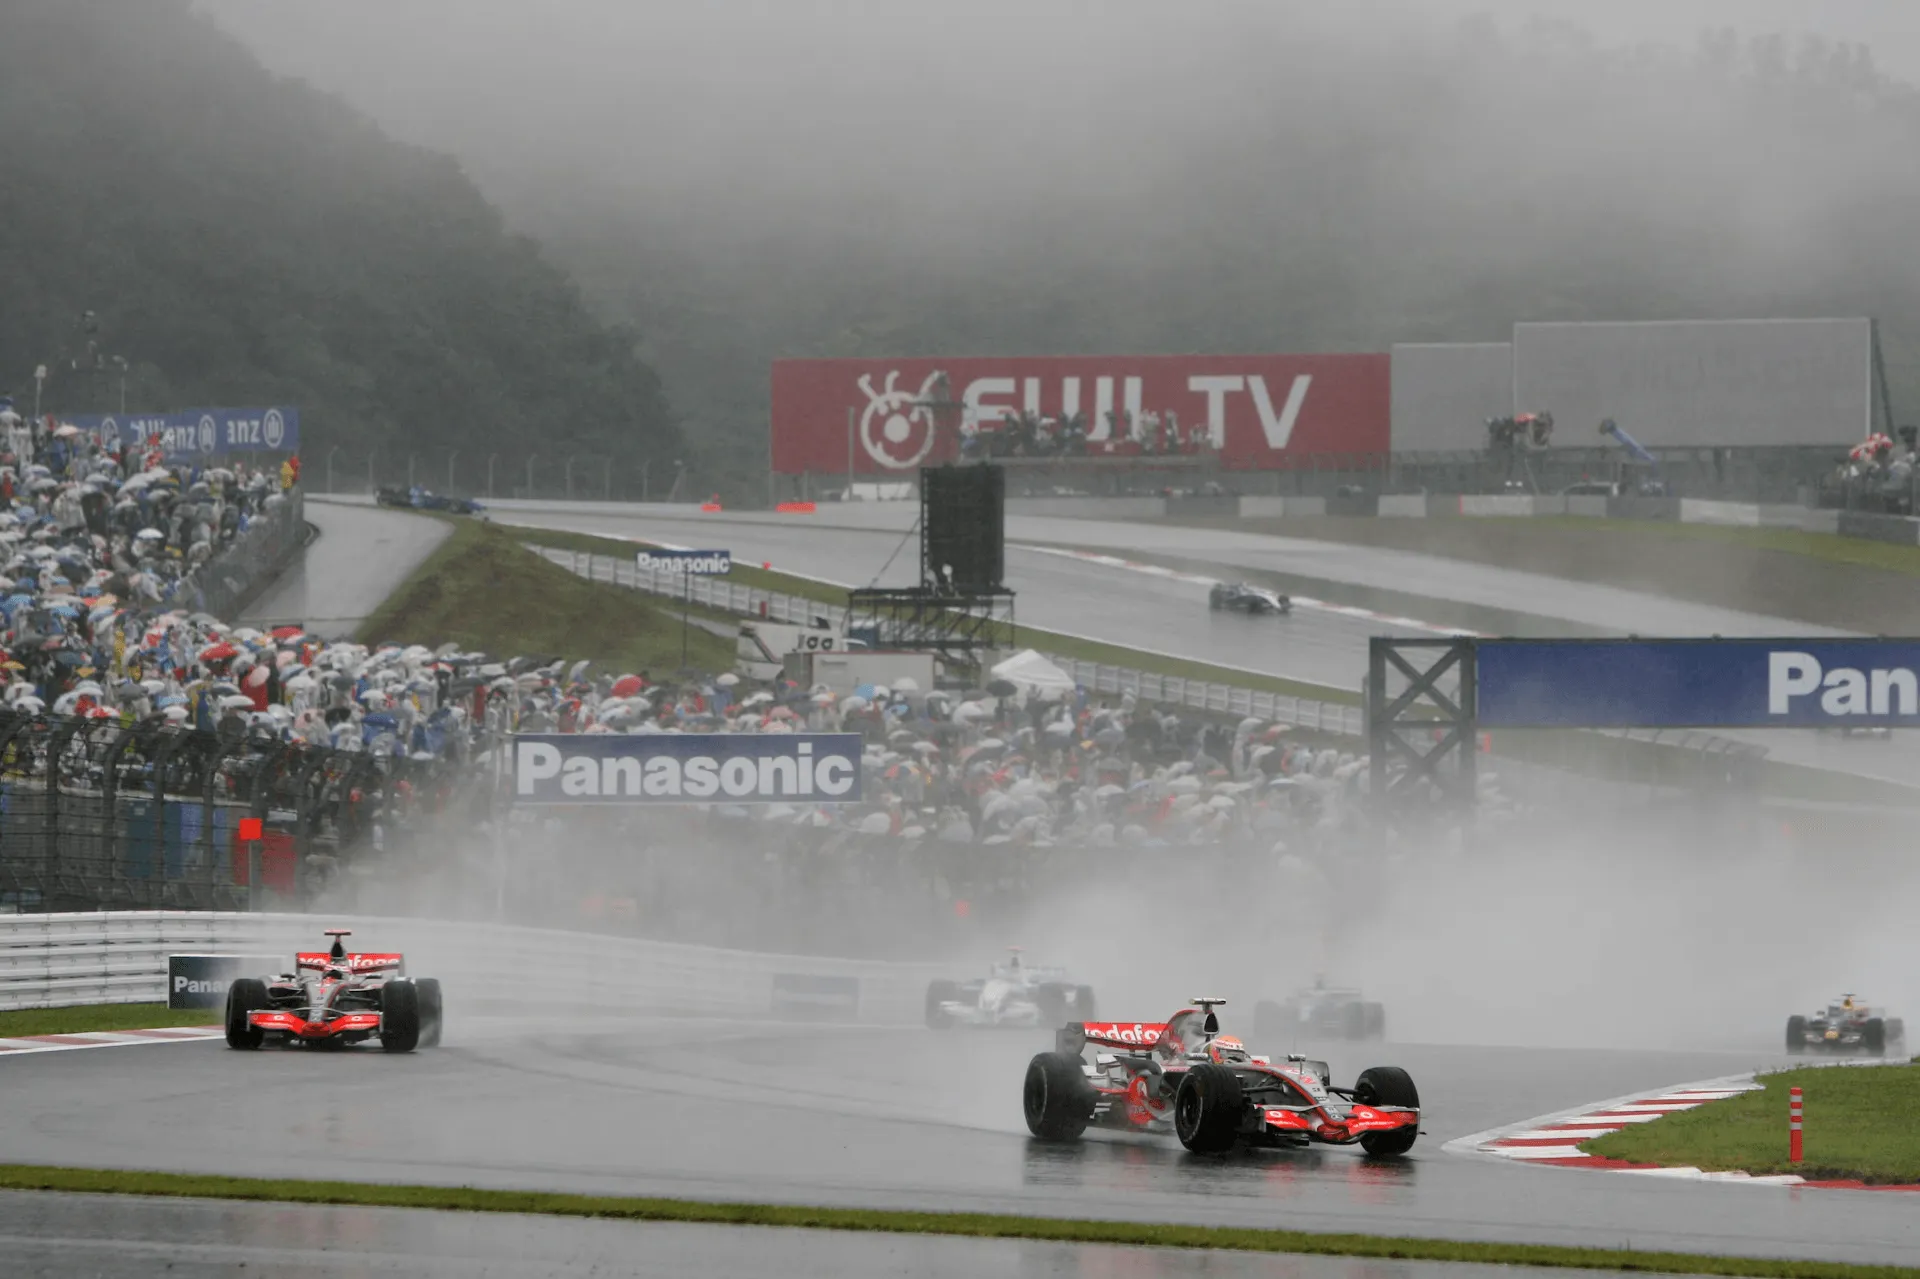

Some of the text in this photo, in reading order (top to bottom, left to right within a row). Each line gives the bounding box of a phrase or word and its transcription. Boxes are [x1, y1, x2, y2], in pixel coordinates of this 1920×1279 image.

[1187, 374, 1313, 450] TV
[637, 552, 730, 574] Panasonic
[517, 742, 855, 796] Panasonic
